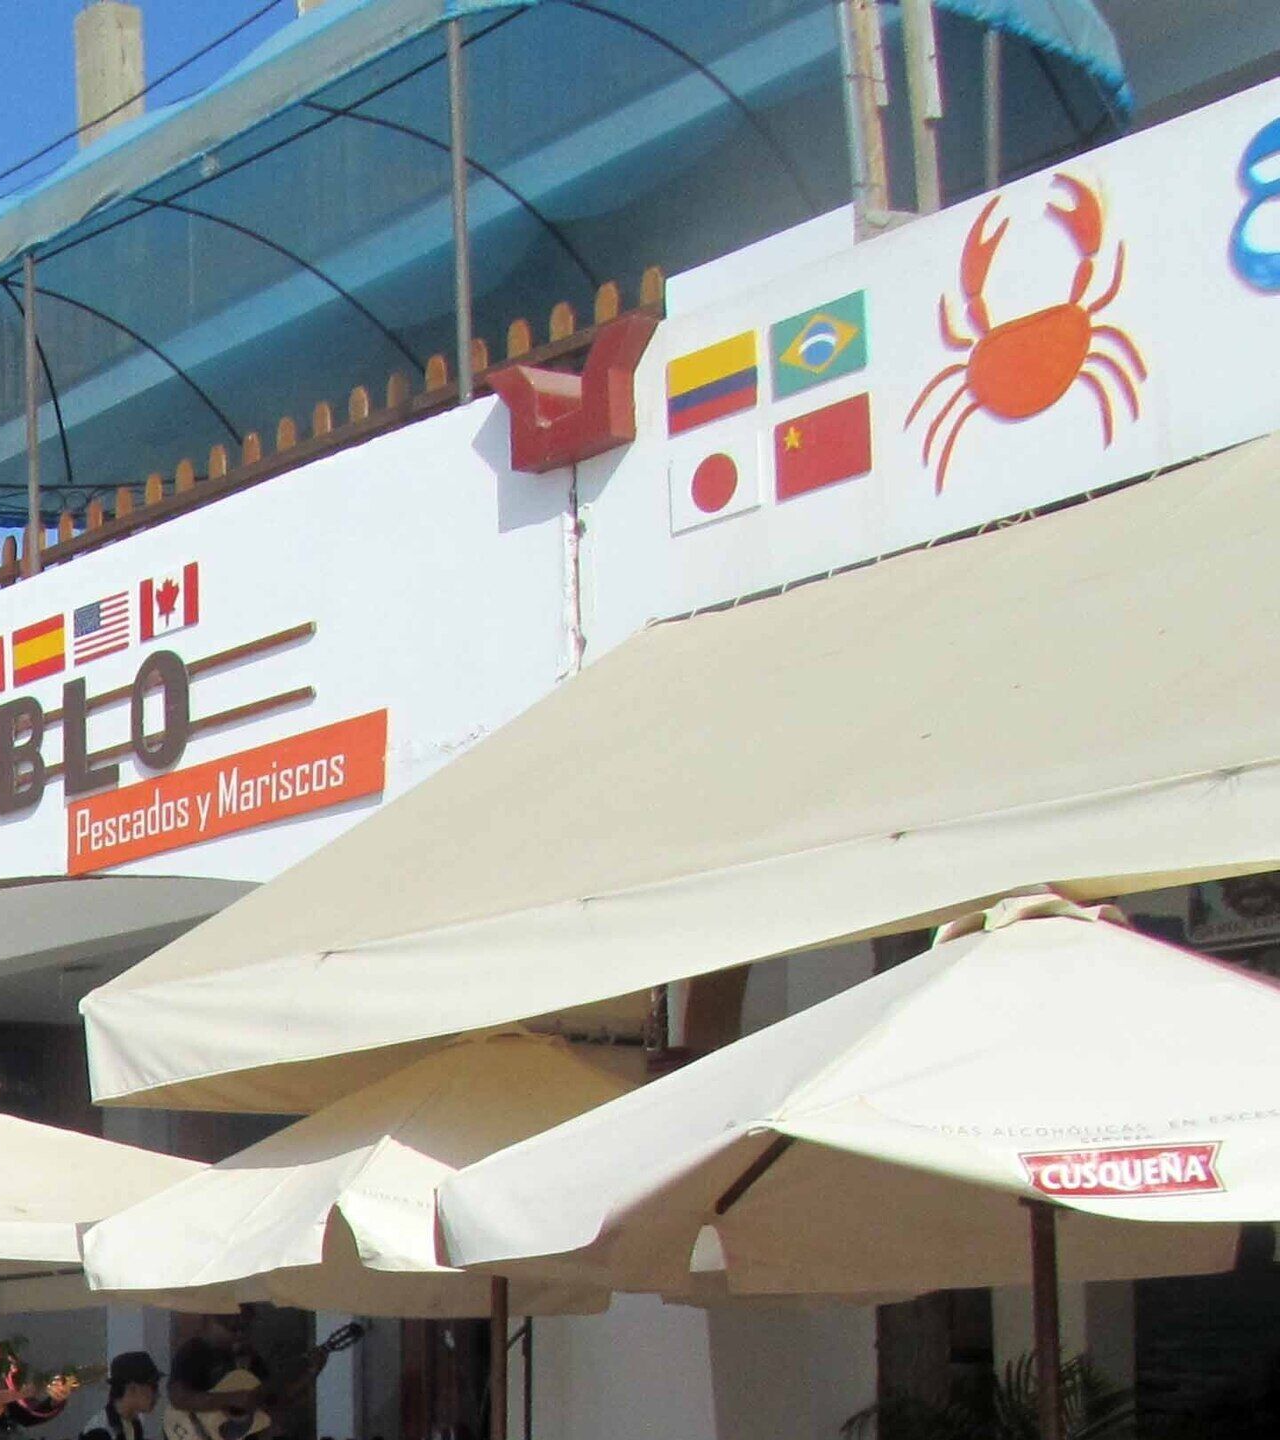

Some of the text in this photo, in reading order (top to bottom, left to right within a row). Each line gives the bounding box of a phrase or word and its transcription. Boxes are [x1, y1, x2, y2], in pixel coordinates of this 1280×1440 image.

[75, 752, 346, 855] Pescados y Mariscos
[1039, 1152, 1208, 1192] CUSQUEÑA
